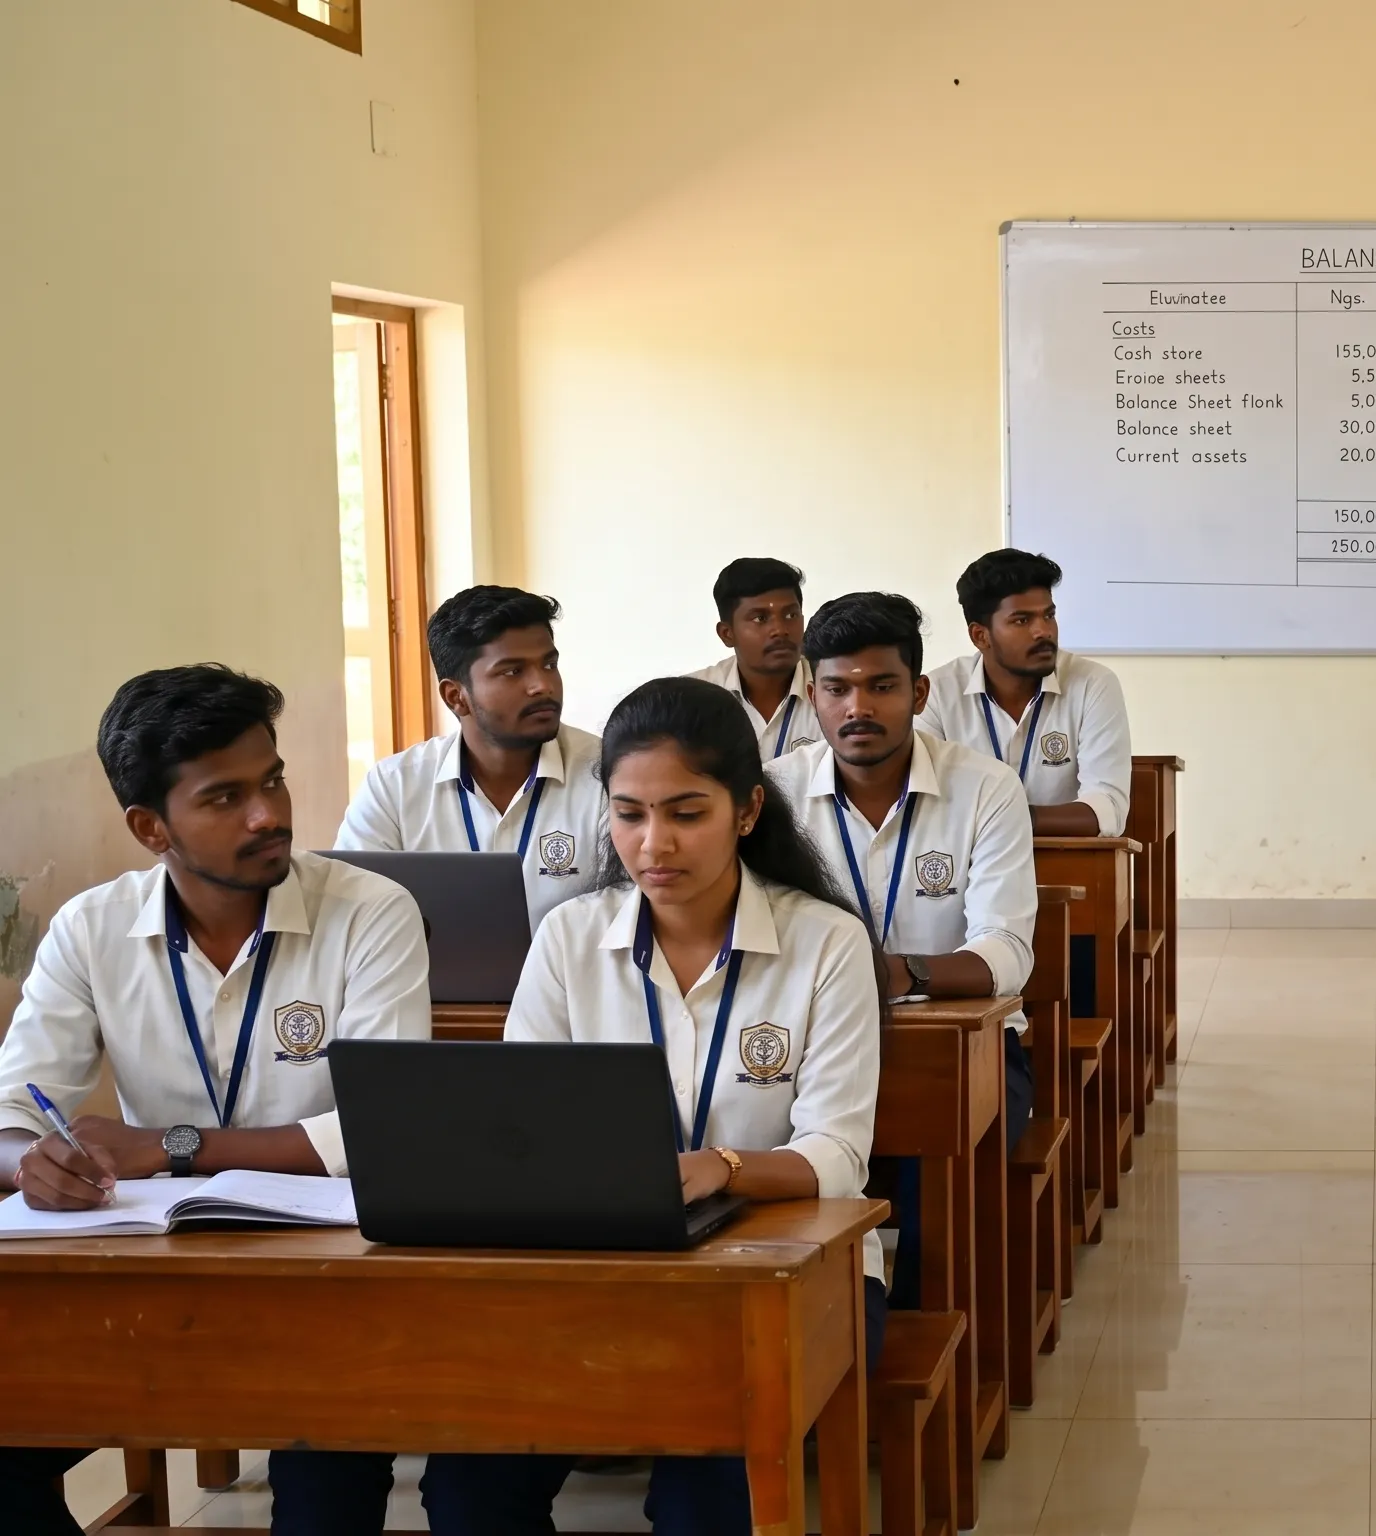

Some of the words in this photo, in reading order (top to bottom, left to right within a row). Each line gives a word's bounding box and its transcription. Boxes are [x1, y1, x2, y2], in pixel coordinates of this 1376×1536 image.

[1331, 289, 1366, 309] Ngs.
[1112, 321, 1155, 335] Costs
[1162, 346, 1202, 360] store
[1175, 370, 1225, 384] sheets
[1116, 393, 1177, 409] Balance
[1188, 394, 1231, 409] Sheet
[1117, 419, 1178, 435] Balance
[1190, 421, 1232, 435] sheet
[1116, 447, 1179, 463] Current
[1192, 449, 1247, 463] assets
